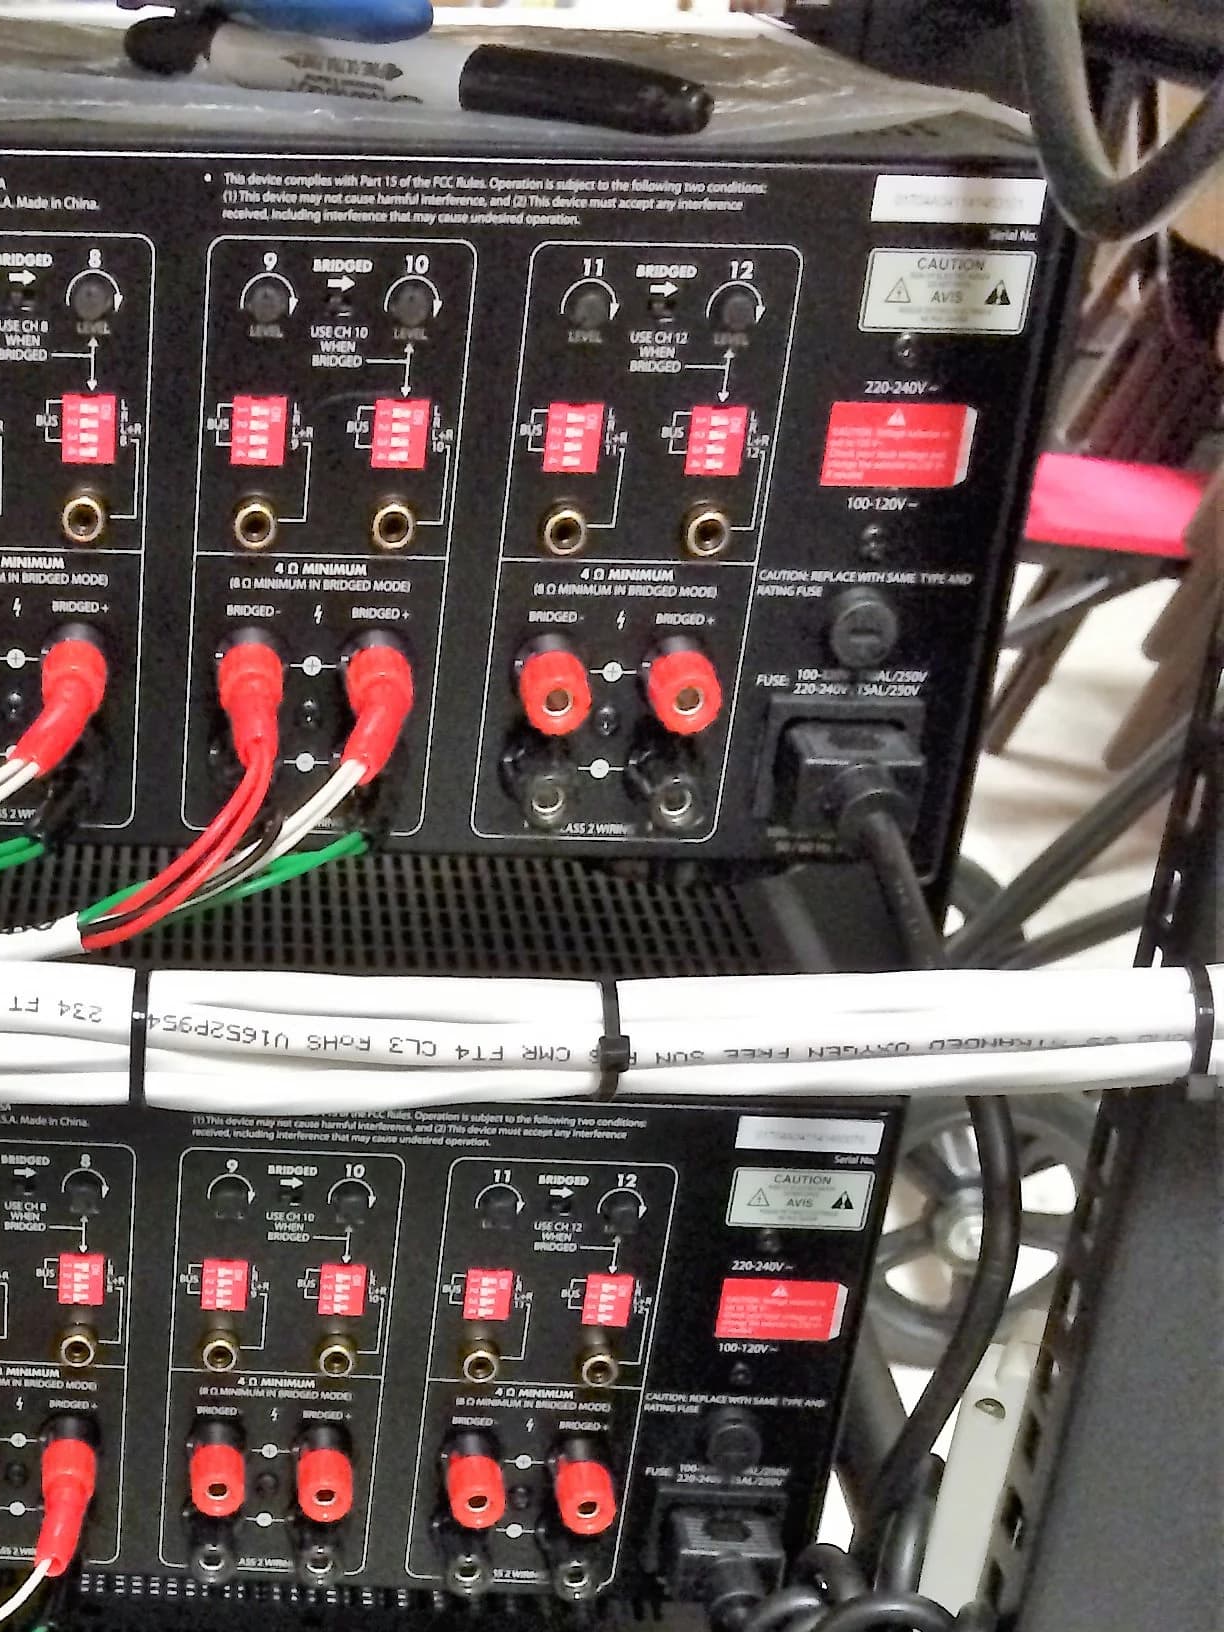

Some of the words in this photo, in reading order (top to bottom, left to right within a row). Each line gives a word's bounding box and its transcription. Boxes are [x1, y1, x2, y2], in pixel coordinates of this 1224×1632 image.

[225, 173, 245, 186] This
[247, 174, 283, 187] device
[284, 175, 332, 189] complies
[334, 175, 358, 187] with
[360, 175, 382, 188] Part
[384, 176, 397, 188] 15
[413, 177, 431, 189] the
[433, 177, 453, 189] FCC
[489, 178, 544, 192] Operation
[556, 179, 596, 192] subject
[611, 180, 629, 192] the
[632, 180, 683, 195] following
[684, 182, 706, 193] two
[16, 197, 48, 210] Made
[272, 208, 322, 224] including
[323, 209, 388, 223] interference
[389, 210, 412, 223] that
[413, 212, 437, 226] may
[438, 213, 468, 224] cause
[470, 211, 525, 225] undesired
[88, 248, 102, 268] 8
[264, 252, 278, 271] 9
[404, 255, 430, 275] 10
[917, 257, 986, 272] CAUTION
[312, 259, 373, 274] BRIDGED
[582, 258, 605, 277] 11
[636, 263, 698, 280] BRIDGED
[729, 260, 755, 280] 12
[930, 290, 963, 305] AVIS
[319, 339, 356, 354] WHEN
[639, 345, 676, 359] WHEN
[311, 353, 362, 369] BRIDGED
[629, 358, 682, 374] BRIDGED
[864, 380, 927, 396] 220-240V
[846, 496, 906, 512] 100-120V
[0, 556, 65, 571] MINIMUM
[301, 563, 368, 577] MINIMUM
[9, 996, 41, 1014] FT
[59, 999, 104, 1023] 234
[388, 1035, 438, 1059] CL3
[456, 1043, 504, 1062] FT4
[522, 1045, 572, 1064] CMR
[773, 1173, 833, 1187] CAUTION
